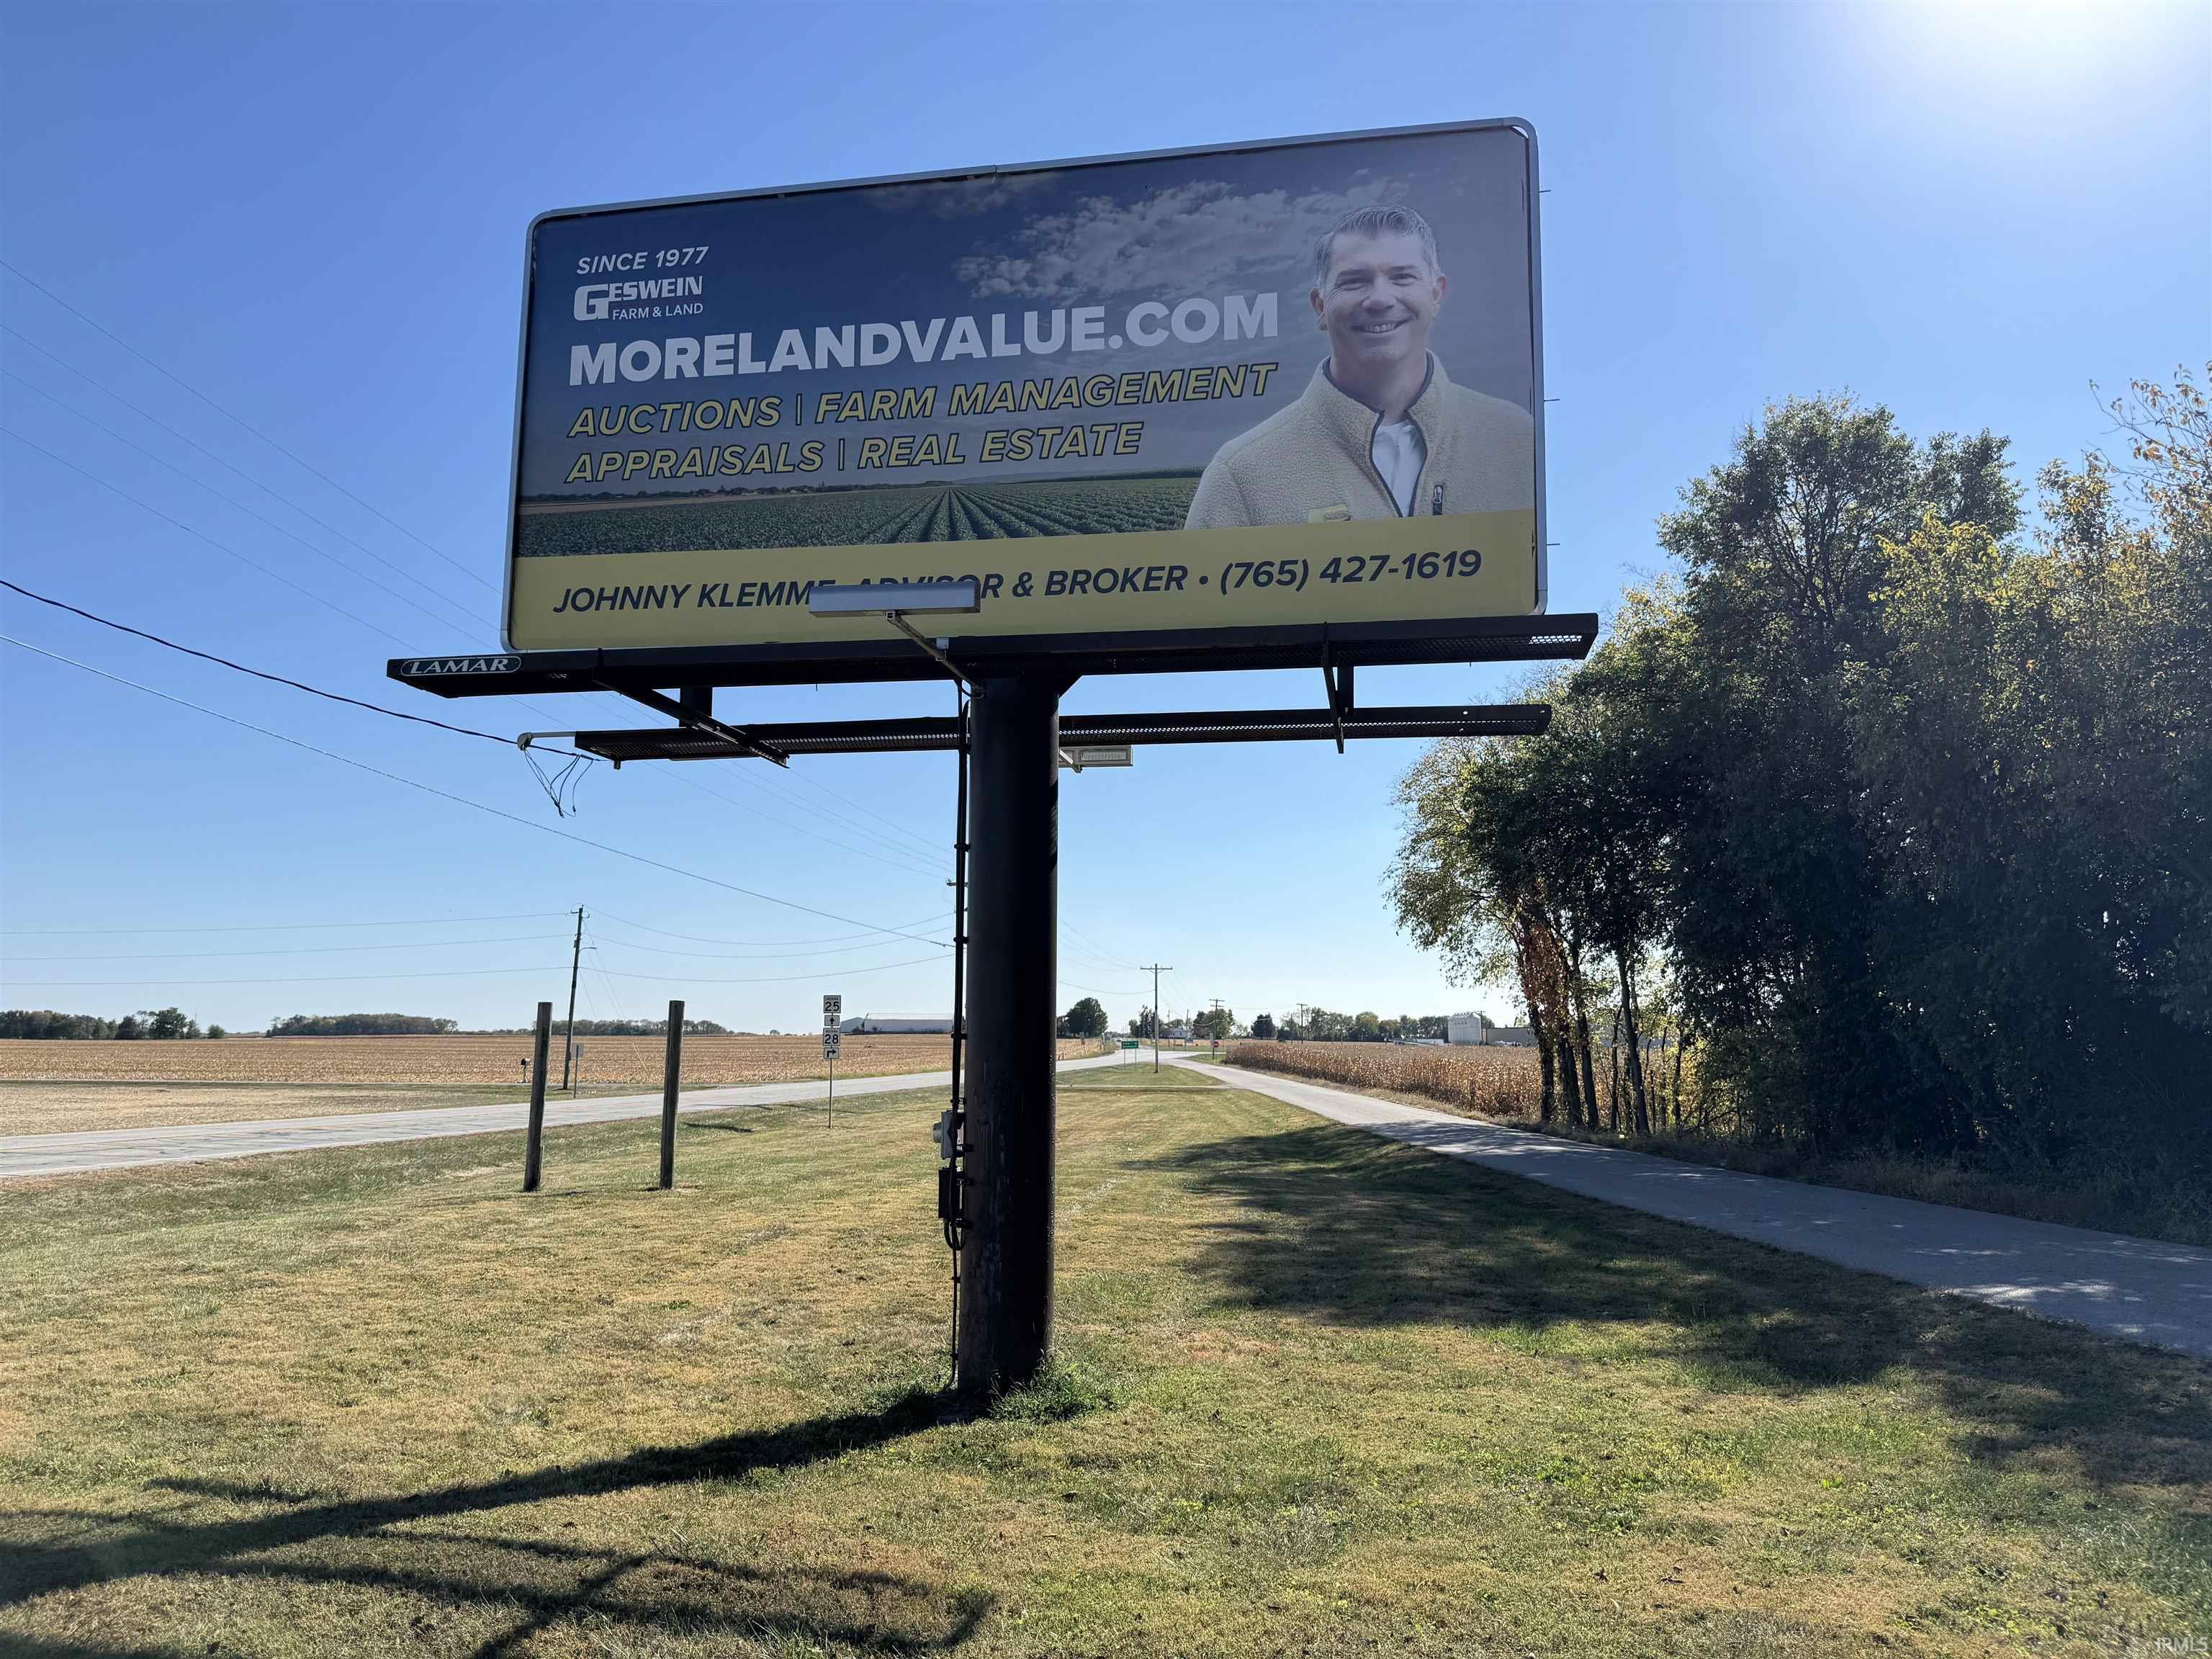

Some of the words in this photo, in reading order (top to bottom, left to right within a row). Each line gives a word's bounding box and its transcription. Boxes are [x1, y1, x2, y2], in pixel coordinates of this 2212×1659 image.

[577, 252, 648, 274] SINCE
[655, 246, 709, 268] 1977
[573, 276, 703, 321] GESWEIN
[613, 307, 649, 320] FARM
[652, 306, 662, 318] &
[665, 302, 703, 316] LAND
[569, 292, 1279, 386] MORELANDVALUE.COM
[567, 394, 782, 439] AUCTIONS
[814, 385, 938, 424] FARM
[948, 362, 1279, 416] MANAGEMENT
[564, 438, 825, 484] APPRAISALS
[858, 433, 966, 469] REAL
[979, 421, 1144, 463] ESTATE
[553, 583, 692, 613] JOHNNY
[696, 579, 836, 608] KLEMM
[1012, 572, 1034, 598] &
[1044, 565, 1188, 596] BROKER
[1220, 558, 1310, 595] (765)
[1320, 549, 1482, 584] 427-1619
[410, 657, 508, 674] LAMAR
[824, 1002, 840, 1011] 25
[824, 1034, 839, 1044] 28
